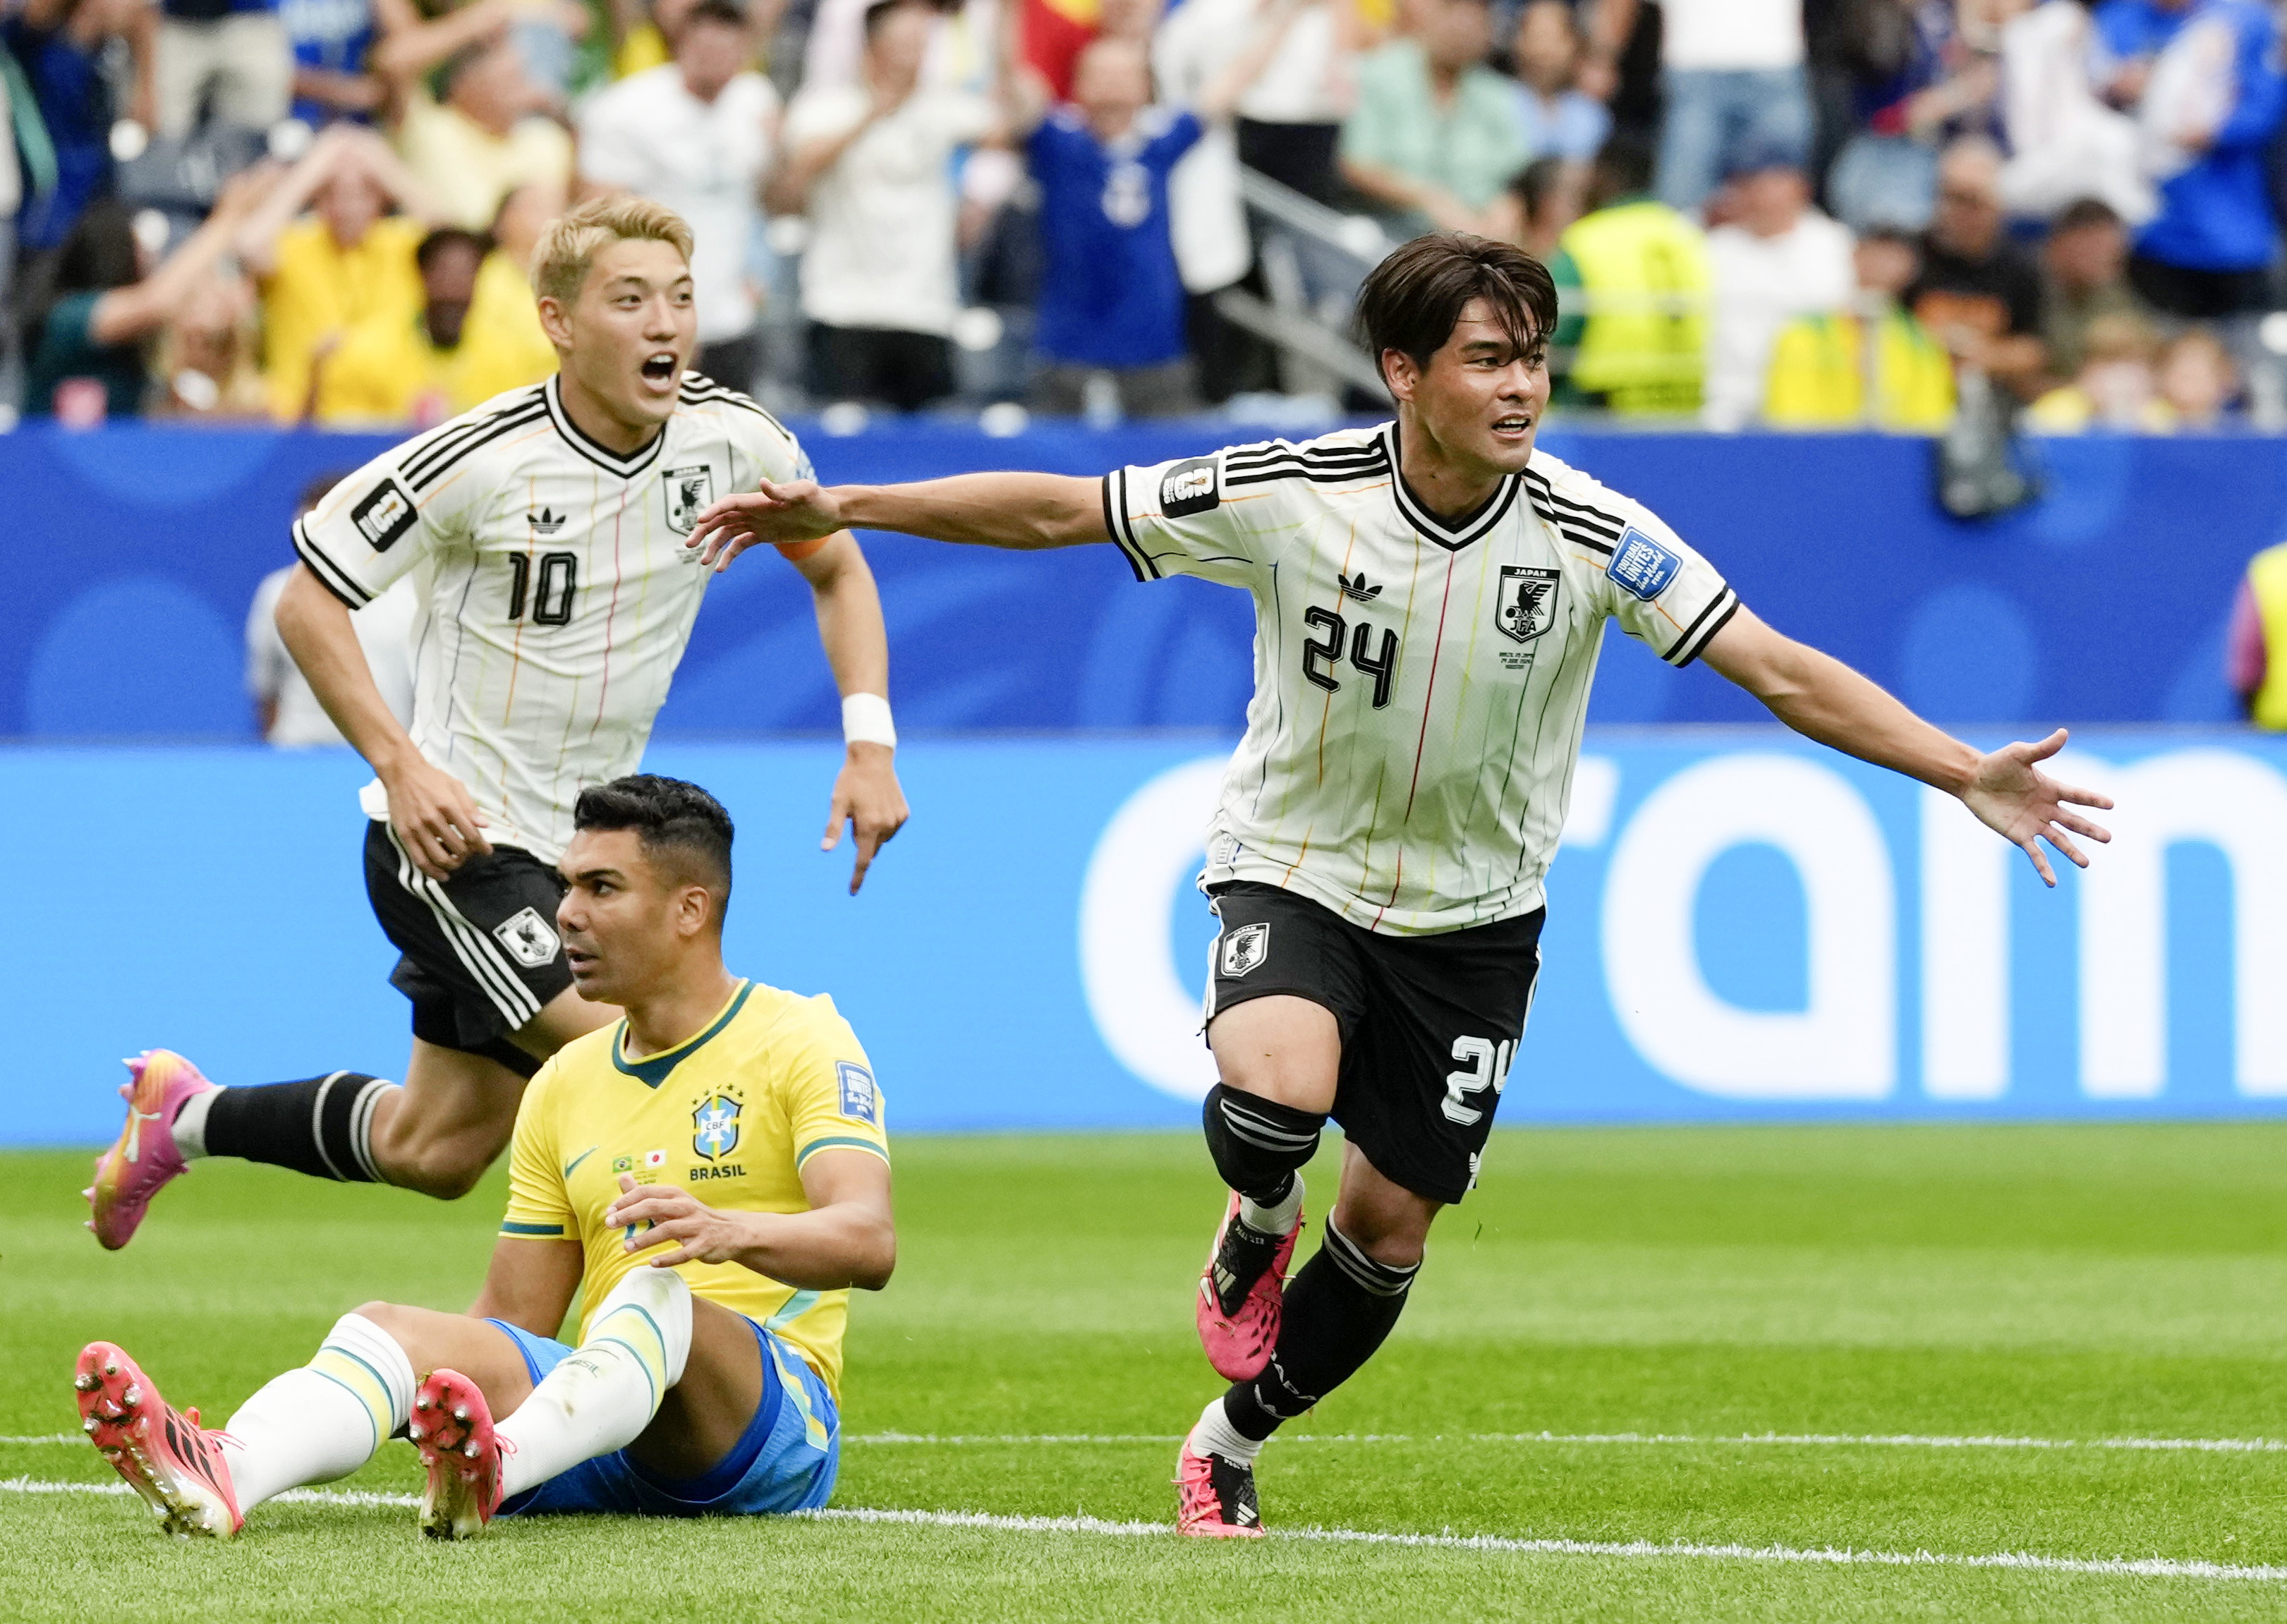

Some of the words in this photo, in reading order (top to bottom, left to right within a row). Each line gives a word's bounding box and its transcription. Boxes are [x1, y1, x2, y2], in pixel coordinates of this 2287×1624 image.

[1514, 568, 1547, 577] JAPAN
[1615, 540, 1643, 575] FOOTBALL
[1623, 544, 1654, 582] UNITES
[509, 551, 577, 626] 10
[1302, 605, 1400, 710] 24
[706, 1120, 724, 1130] CBF
[690, 1165, 746, 1181] BRASIL
